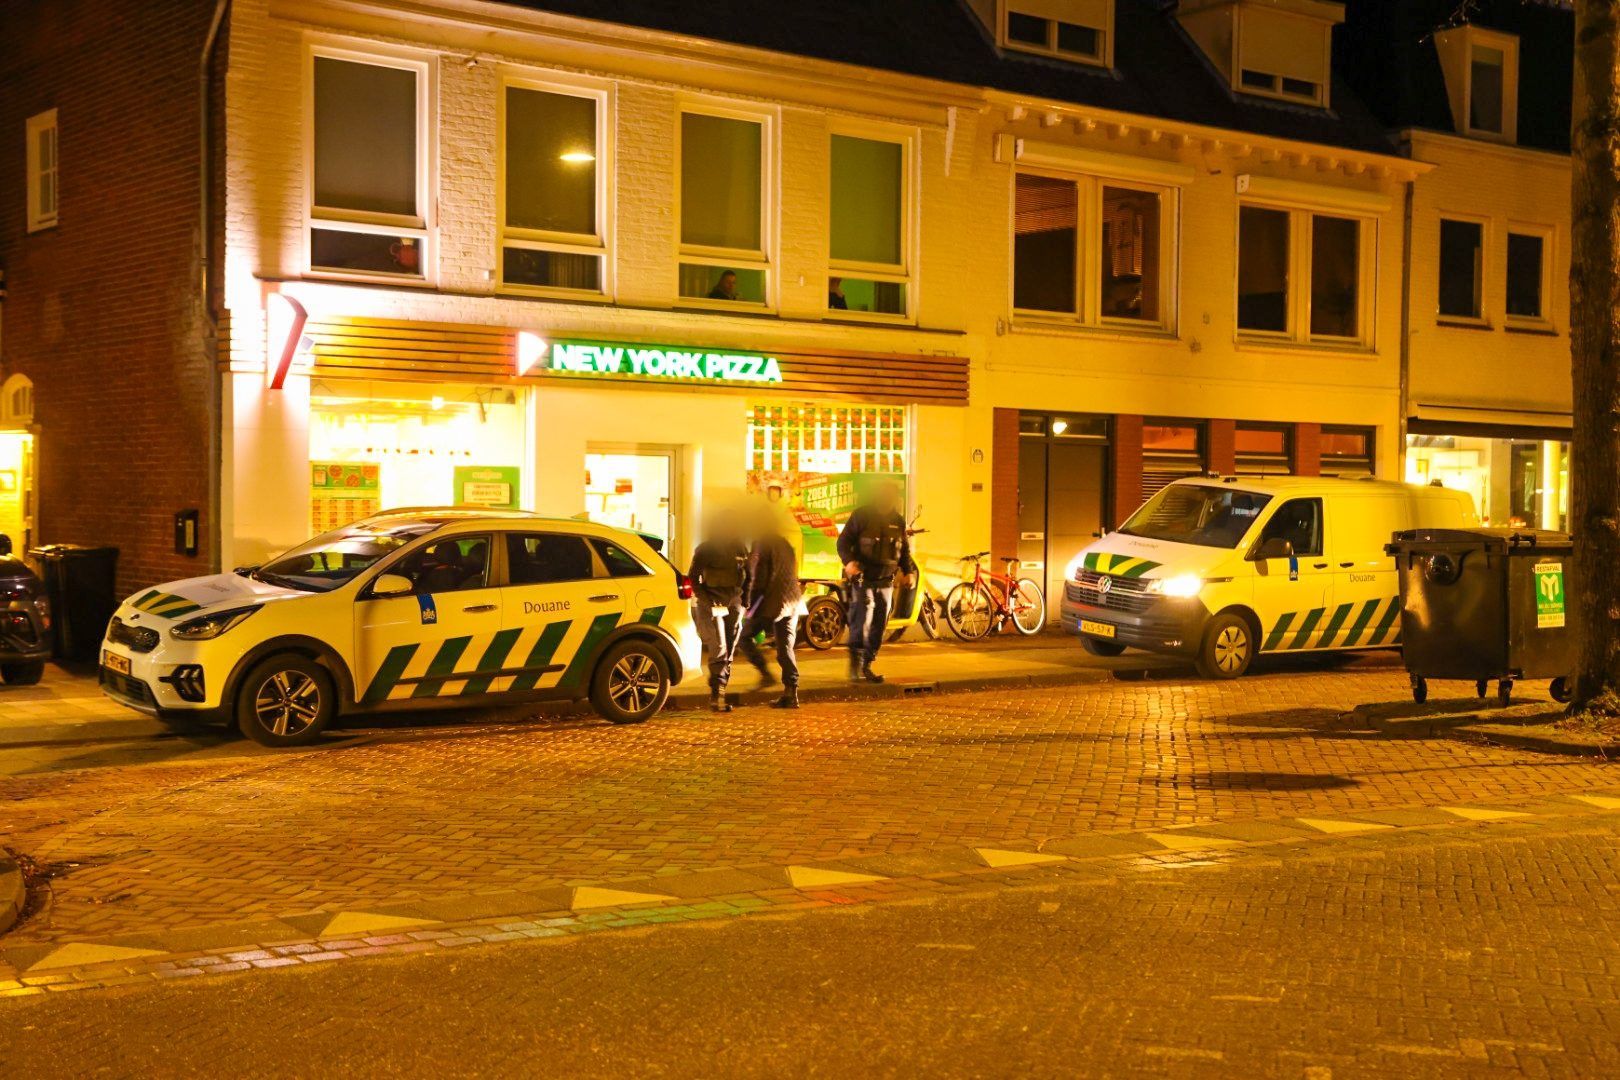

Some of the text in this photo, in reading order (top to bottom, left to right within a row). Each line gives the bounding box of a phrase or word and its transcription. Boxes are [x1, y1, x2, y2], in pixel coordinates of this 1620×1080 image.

[553, 344, 783, 383] NEW YORK PIZZA
[807, 486, 828, 501] ZOEK
[829, 483, 838, 497] JE
[838, 480, 853, 494] EEN
[1349, 573, 1376, 582] Douane
[523, 600, 571, 615] Douane
